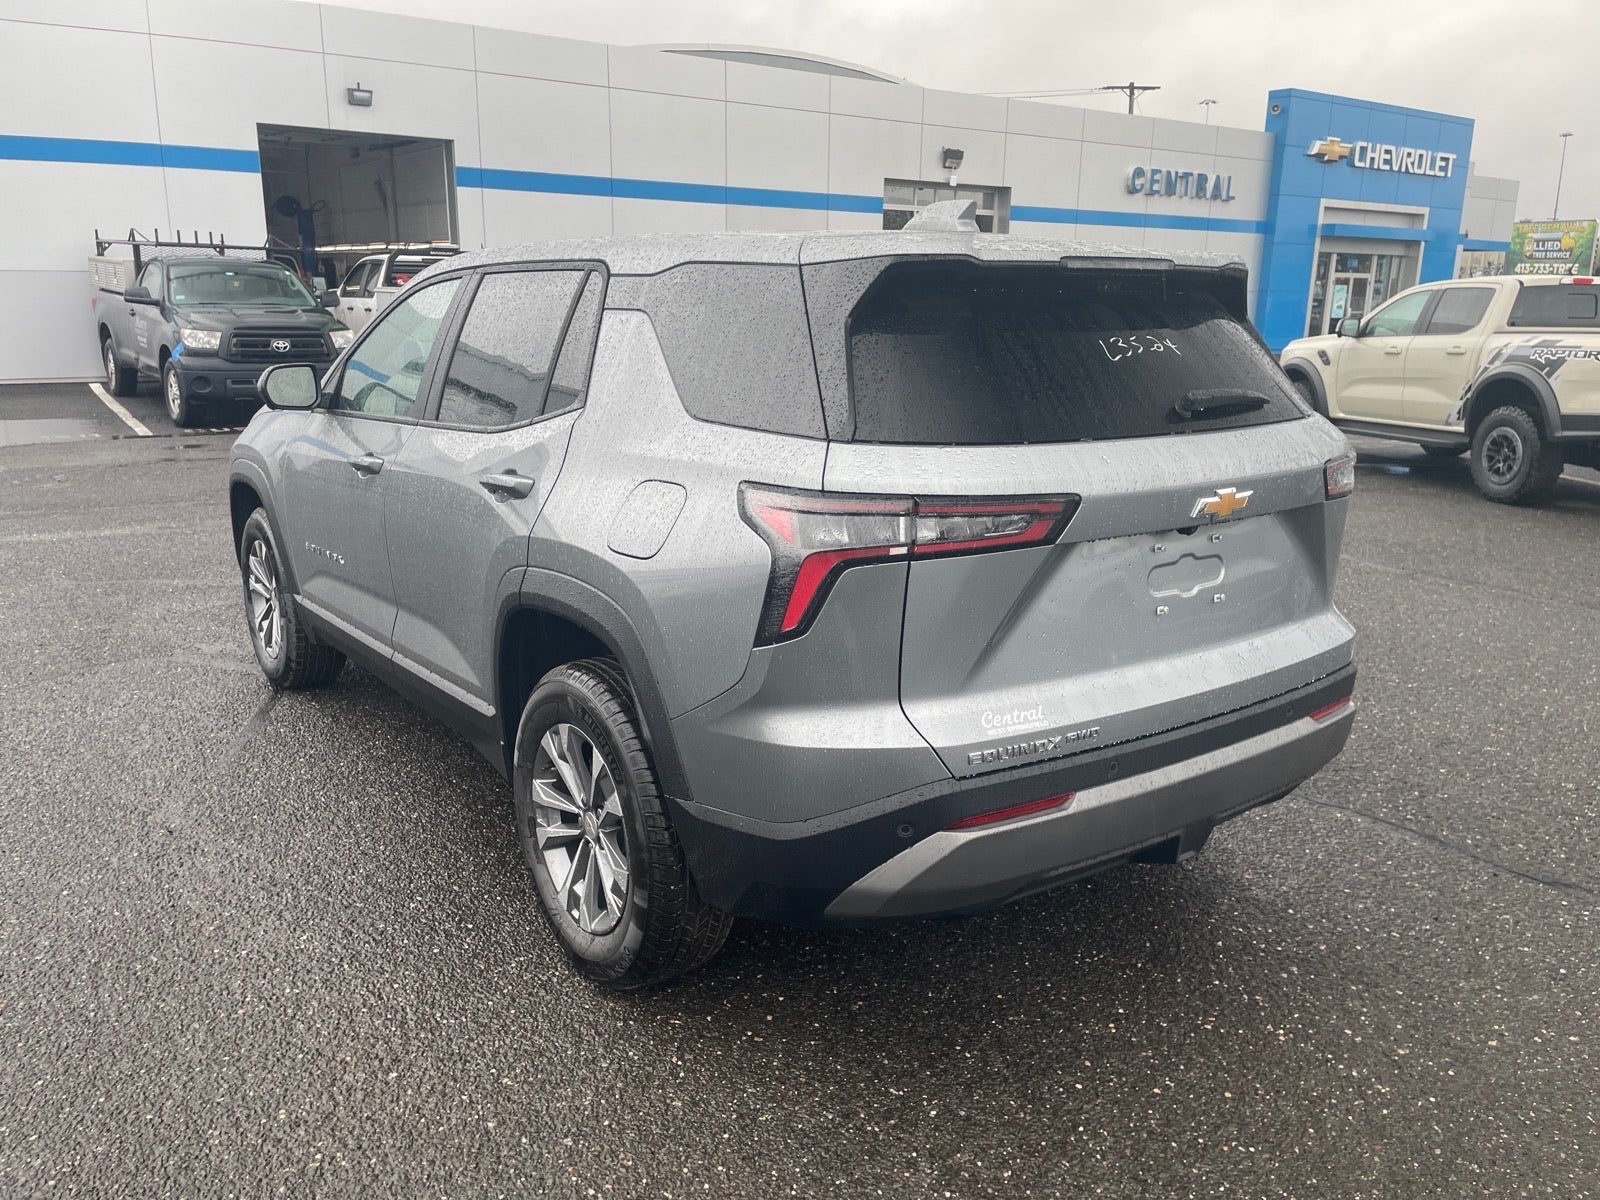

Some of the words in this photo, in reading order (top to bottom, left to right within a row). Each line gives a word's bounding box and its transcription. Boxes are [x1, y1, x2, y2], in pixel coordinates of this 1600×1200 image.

[1353, 141, 1457, 178] CHEVROLET
[1126, 166, 1236, 201] CENTRAL
[1533, 251, 1546, 259] TREE
[1547, 251, 1571, 259] SERVICE
[1530, 347, 1600, 364] RAPTOR
[981, 705, 1045, 728] Central
[968, 735, 1063, 767] EQUINOX
